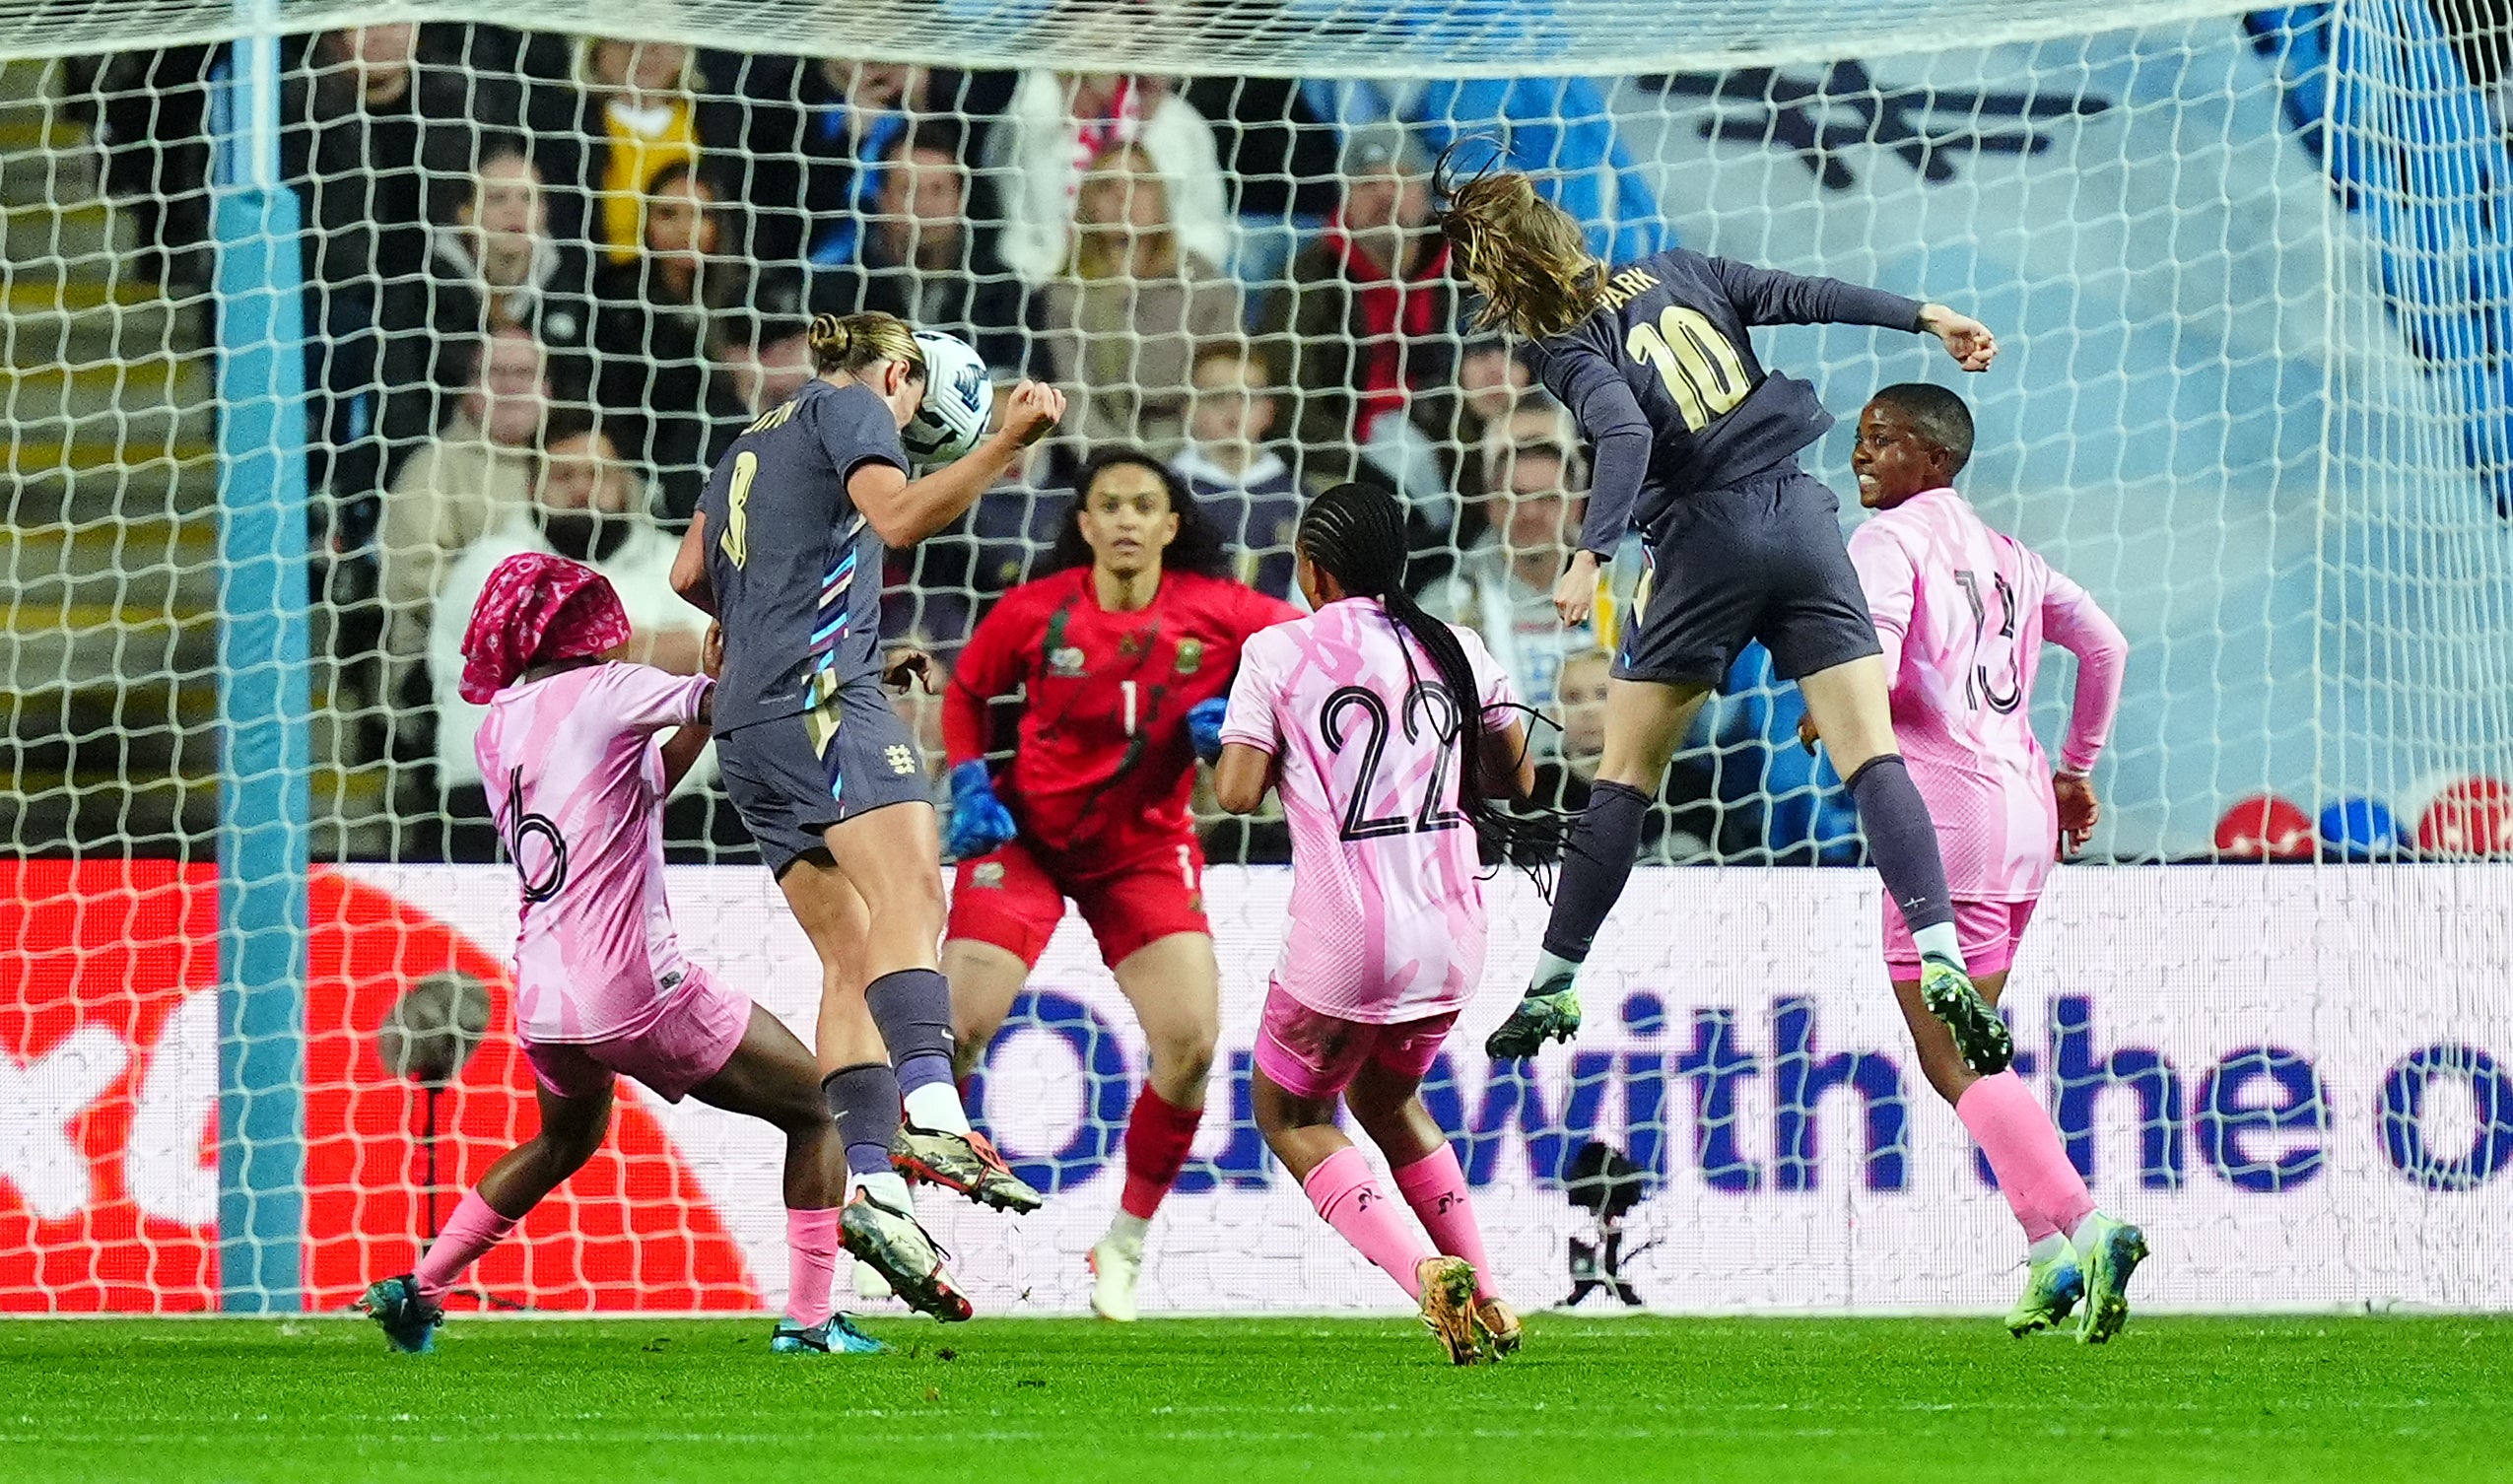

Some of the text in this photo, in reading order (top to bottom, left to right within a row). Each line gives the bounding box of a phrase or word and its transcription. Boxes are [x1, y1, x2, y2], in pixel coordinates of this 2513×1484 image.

[1626, 305, 1751, 434] 10
[1120, 680, 1137, 737] 1
[1953, 569, 2022, 715] 13
[1320, 680, 1460, 842] 22
[509, 764, 568, 903] 6
[1176, 843, 1195, 890] 1
[1413, 989, 1910, 1190] with
[1975, 995, 2330, 1194] he
